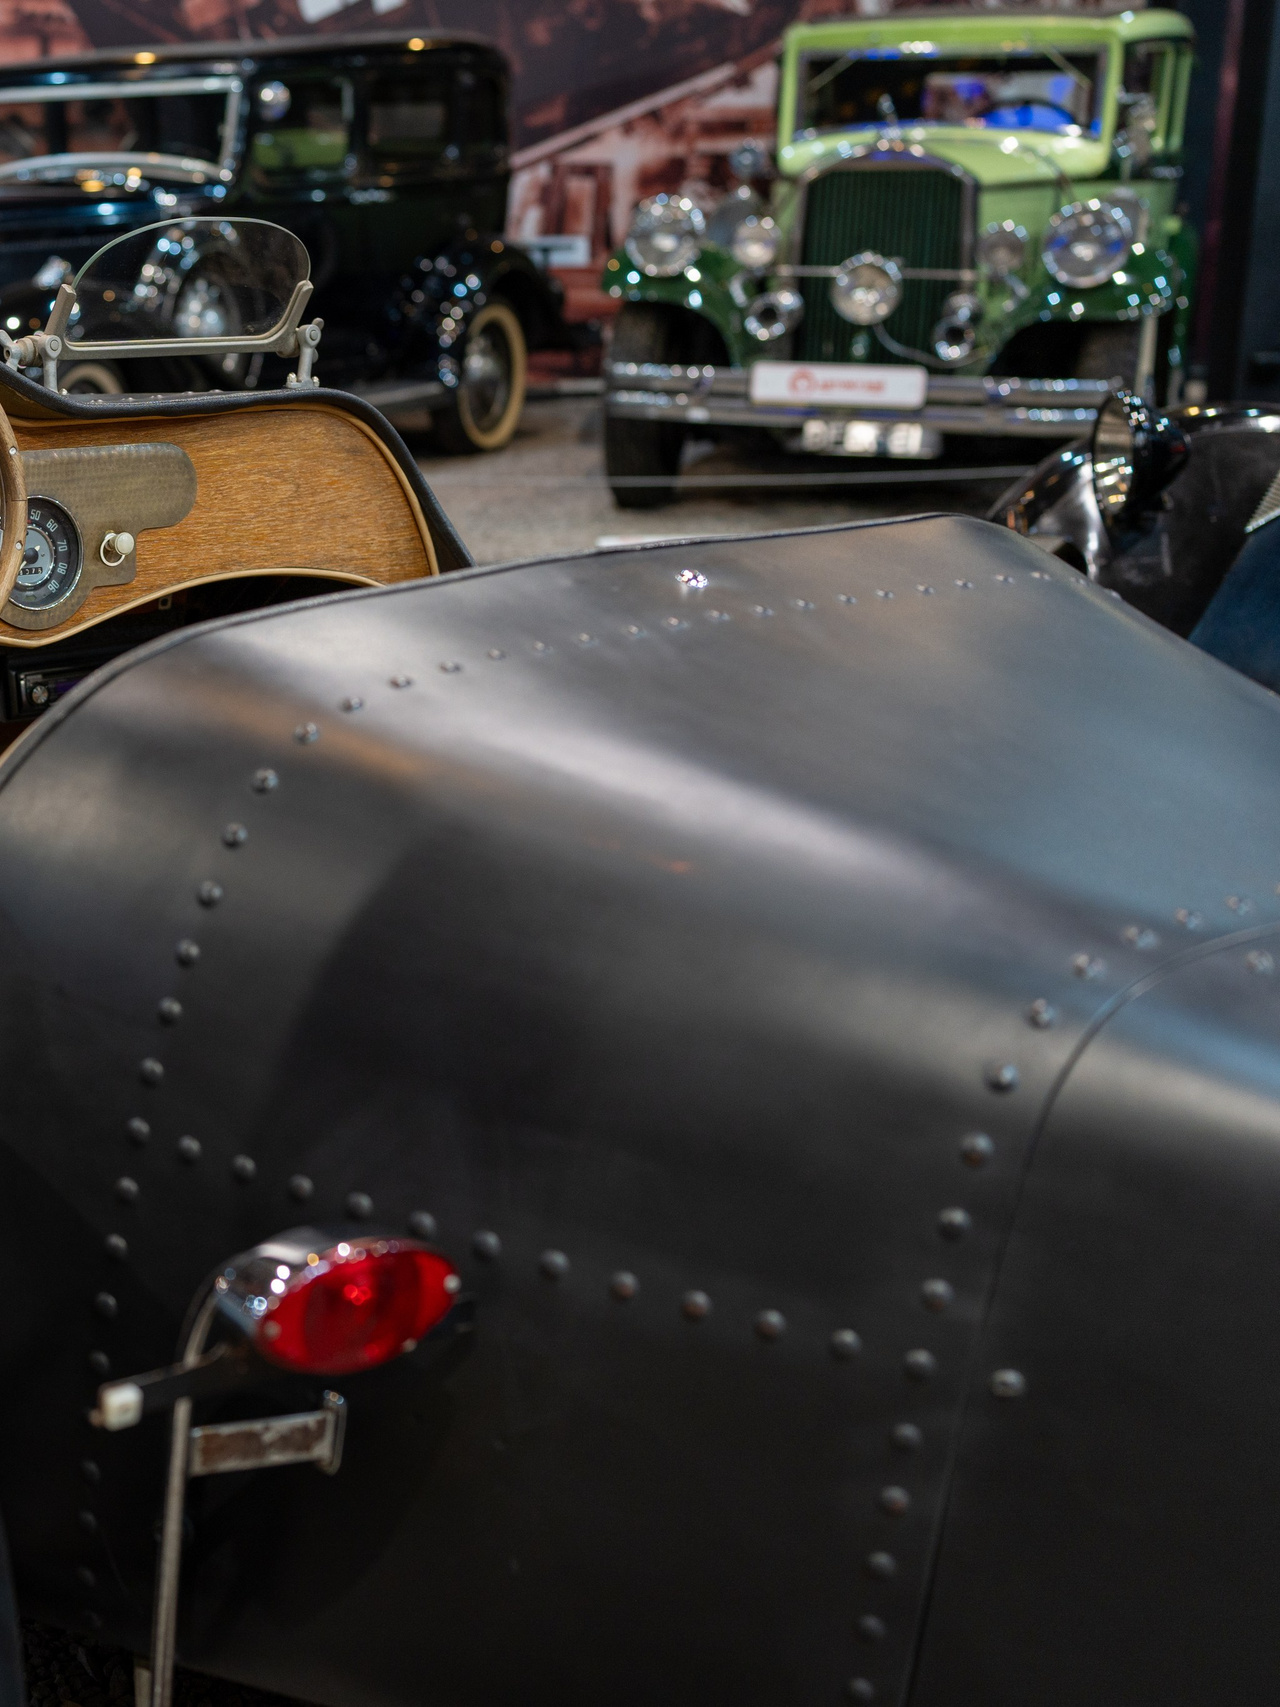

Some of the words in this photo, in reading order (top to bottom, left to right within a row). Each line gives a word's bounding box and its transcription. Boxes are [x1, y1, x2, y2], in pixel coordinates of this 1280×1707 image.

[30, 509, 41, 521] 50
[46, 519, 58, 532] 60
[57, 539, 68, 552] 70
[57, 562, 68, 575] 80
[47, 580, 59, 593] 90
